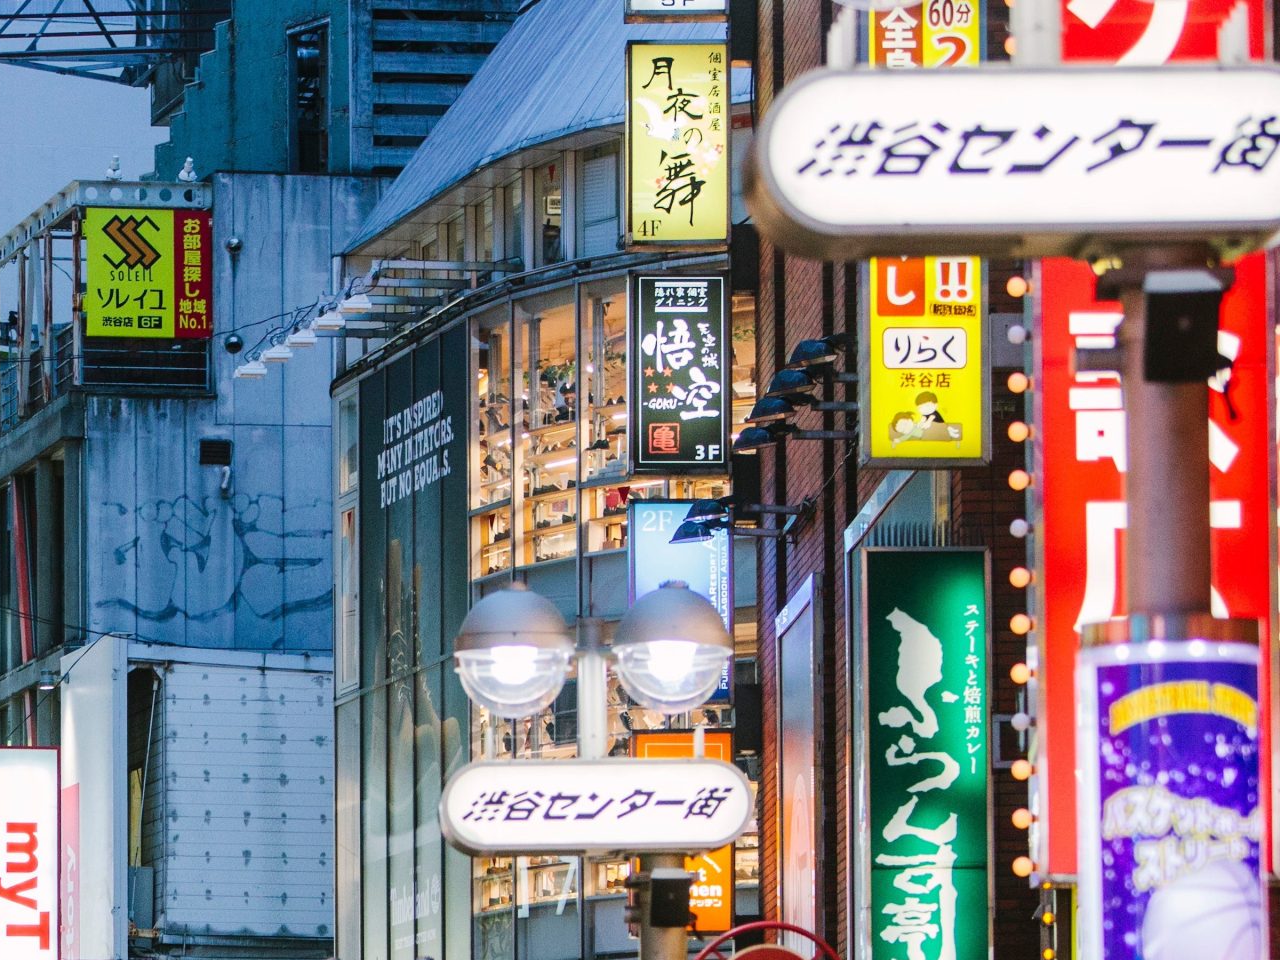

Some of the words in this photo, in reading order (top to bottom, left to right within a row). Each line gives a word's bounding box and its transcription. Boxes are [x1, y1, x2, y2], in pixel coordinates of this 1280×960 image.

[929, 0, 971, 27] 60分
[708, 52, 721, 131] 個室居酒屋
[642, 57, 707, 226] 月夜の舞
[798, 117, 1280, 176] 渋谷センター街
[638, 220, 661, 236] 4F
[184, 219, 201, 297] お部屋探し
[111, 269, 153, 281] SOLEIL
[97, 289, 166, 310] ソレイユ
[655, 288, 708, 297] 隠れ家個室
[655, 298, 708, 307] ダイニング
[179, 299, 206, 314] 地域
[103, 317, 133, 327] 渋谷店
[141, 317, 160, 328] 6F
[180, 315, 206, 329] No.1
[894, 333, 958, 365] りらく
[641, 318, 720, 420] 悟空
[900, 373, 951, 389] 渋谷店
[377, 442, 402, 480] MANY
[695, 445, 720, 460] 3F
[381, 476, 397, 509] BUT
[399, 469, 412, 500] NO
[642, 510, 672, 532] 2F
[963, 604, 982, 776] ステーキと焙煎カレー
[462, 787, 733, 822] 渋谷センター街
